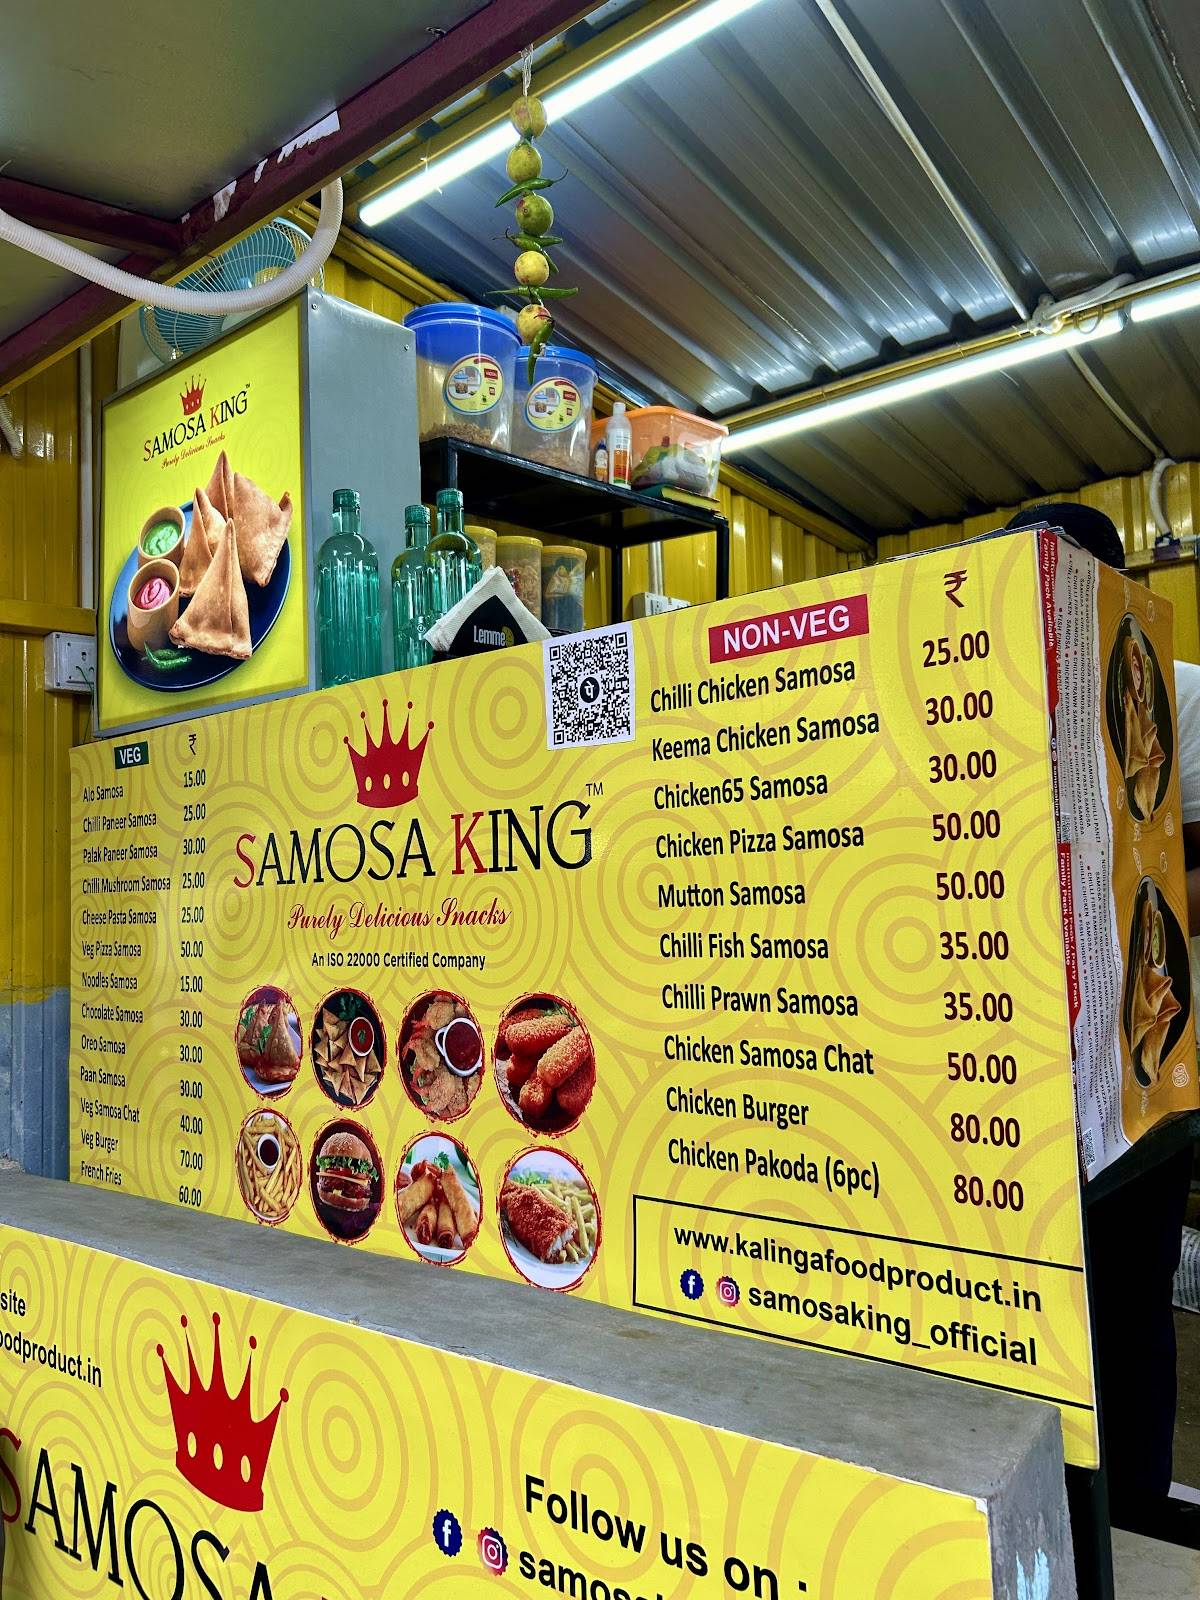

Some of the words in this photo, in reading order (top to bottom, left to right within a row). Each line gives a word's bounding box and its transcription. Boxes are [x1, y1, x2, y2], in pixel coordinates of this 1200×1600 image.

[144, 413, 206, 461] SAMOSA
[210, 391, 247, 429] KING
[161, 455, 179, 469] Purely
[181, 445, 205, 460] Delicious
[944, 570, 967, 608] ₹
[474, 625, 505, 646] Lemme
[724, 605, 849, 655] NON-VEG
[923, 630, 989, 667] 25.00
[651, 683, 692, 712] Chilli
[698, 674, 769, 704] Chicken
[775, 661, 855, 692] Samosa
[926, 690, 993, 725] 30.00
[189, 734, 196, 755] ₹
[653, 737, 710, 761] Keema
[717, 722, 790, 752] Chicken
[797, 713, 879, 742] Samosa
[120, 747, 141, 764] VEG
[929, 750, 996, 783] 30.00
[184, 769, 206, 788] 15.00
[83, 788, 94, 802] Alo
[97, 786, 123, 800] Samosa
[654, 778, 744, 809] Chicken65
[750, 775, 828, 800] Samosa
[83, 816, 100, 833] Chilli
[103, 816, 126, 830] Paneer
[128, 813, 156, 828] Samosa
[184, 803, 206, 821] 25.00
[233, 818, 436, 888] SAMOSA
[451, 800, 592, 875] KING
[586, 782, 603, 796] TM
[933, 810, 1000, 841] 50.00
[84, 846, 101, 863] Palak
[104, 847, 127, 862] Paneer
[129, 844, 157, 859] Samosa
[183, 837, 205, 855] 30.00
[656, 831, 723, 858] Chicken
[730, 828, 776, 854] Pizza
[783, 825, 864, 851] Samosa
[83, 878, 99, 894] Chilli
[102, 876, 139, 893] Mushroom
[142, 876, 170, 891] Samosa
[183, 872, 204, 889] 25.00
[937, 870, 1004, 900] 50.00
[658, 884, 724, 908] Mutton
[730, 881, 805, 906] Samosa
[83, 909, 106, 925] Cheese
[109, 910, 126, 924] Pasta
[129, 909, 156, 924] Samosa
[182, 906, 204, 923] 25.00
[287, 903, 346, 940] Purely
[350, 902, 433, 927] Delicious
[437, 898, 512, 925] Snacks
[82, 942, 94, 960] Veg
[96, 941, 112, 956] Pizza
[114, 941, 141, 956] Samosa
[181, 941, 203, 958] 50.00
[660, 932, 702, 957] Chilli
[709, 932, 744, 958] Fish
[751, 933, 828, 959] Samosa
[940, 931, 1009, 960] 35.00
[312, 953, 324, 966] An
[328, 953, 343, 966] ISO
[347, 953, 380, 967] 22000
[384, 952, 428, 967] Certified
[433, 952, 485, 971] Company
[82, 972, 108, 988] Noodles
[110, 973, 137, 989] Samosa
[181, 976, 202, 992] 15.00
[662, 983, 705, 1010] Chilli
[711, 986, 771, 1012] Prawn
[777, 987, 858, 1016] Samosa
[944, 992, 1013, 1022] 35.00
[82, 1003, 114, 1021] Chocolate
[116, 1006, 143, 1023] Samosa
[180, 1010, 202, 1028] 30.00
[82, 1034, 97, 1051] Oreo
[99, 1036, 125, 1054] Samosa
[180, 1044, 202, 1063] 30.00
[664, 1034, 733, 1064] Chicken
[740, 1040, 817, 1070] Samosa
[824, 1044, 874, 1074] Chat
[81, 1066, 96, 1082] Paan
[99, 1068, 125, 1087] Samosa
[948, 1052, 1016, 1085] 50.00
[180, 1080, 202, 1099] 30.00
[81, 1097, 93, 1118] Veg
[95, 1100, 121, 1119] Samosa
[123, 1104, 139, 1123] Chat
[667, 1086, 736, 1118] Chicken
[743, 1094, 809, 1130] Burger
[180, 1115, 202, 1135] 40.00
[951, 1113, 1020, 1148] 80.00
[81, 1129, 93, 1149] Veg
[96, 1132, 118, 1153] Burger
[181, 1150, 203, 1171] 70.00
[669, 1138, 738, 1172] Chicken
[746, 1148, 818, 1183] Pakoda
[826, 1156, 879, 1198] (6pc)
[81, 1161, 103, 1181] French
[106, 1167, 121, 1186] Fries
[179, 1185, 201, 1207] 60.00
[954, 1175, 1023, 1211] 80.00
[674, 1226, 1042, 1312] www.kalingafoodproduct.in
[748, 1284, 1037, 1365] samosaking_official
[526, 1474, 646, 1553] Follow
[661, 1532, 708, 1576] us
[724, 1557, 779, 1600] on
